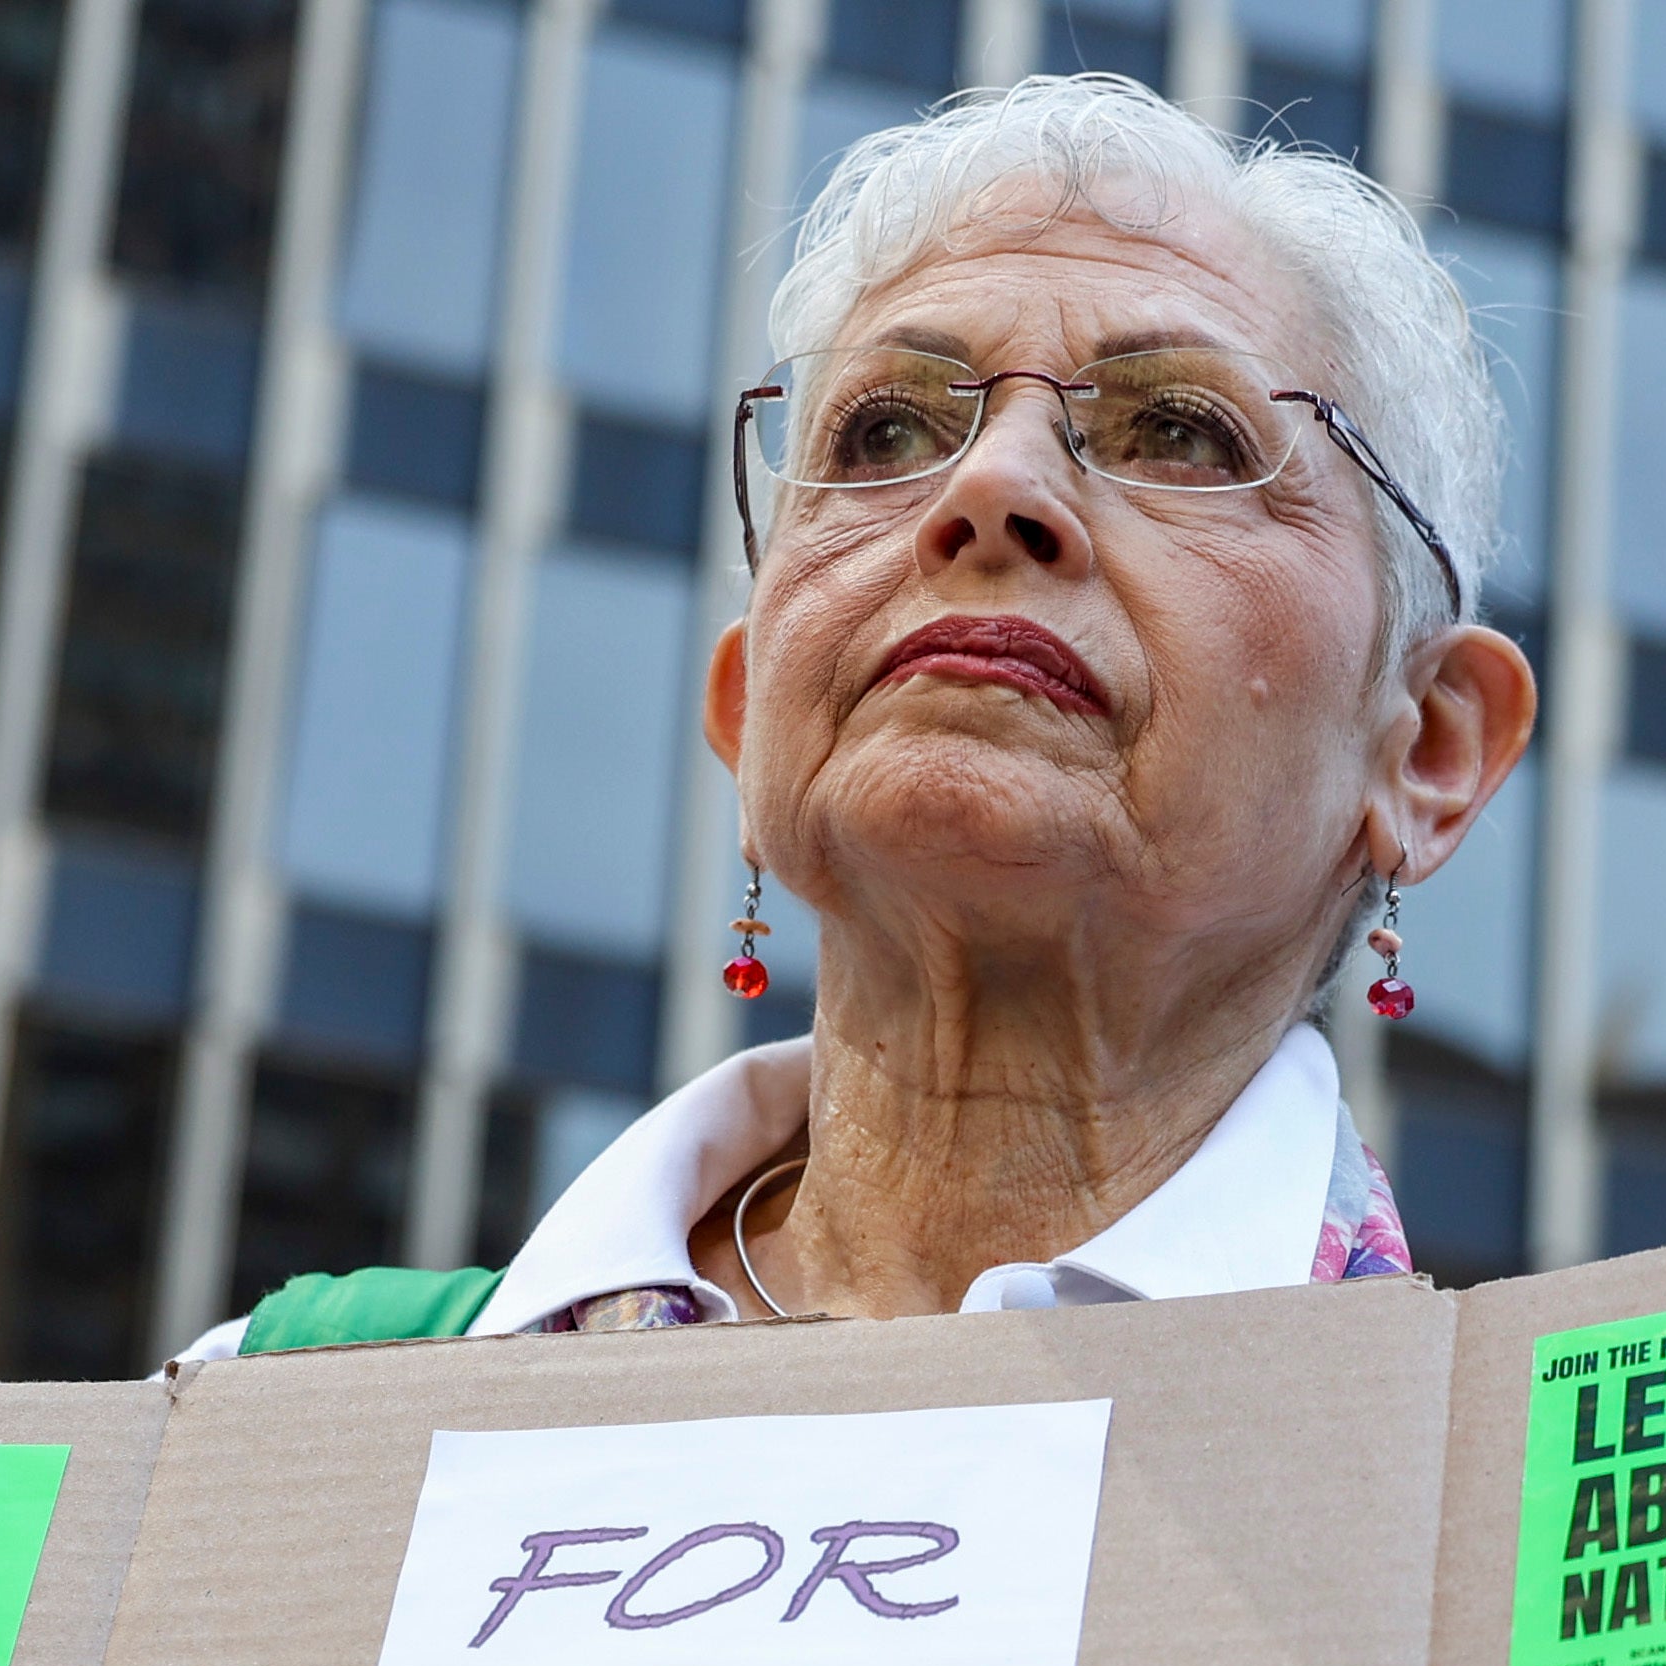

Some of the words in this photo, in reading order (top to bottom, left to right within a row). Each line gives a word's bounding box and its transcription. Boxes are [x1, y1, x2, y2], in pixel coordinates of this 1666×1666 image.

[1542, 1349, 1600, 1383] JOIN
[1609, 1339, 1652, 1369] THE
[467, 1519, 961, 1649] FOR
